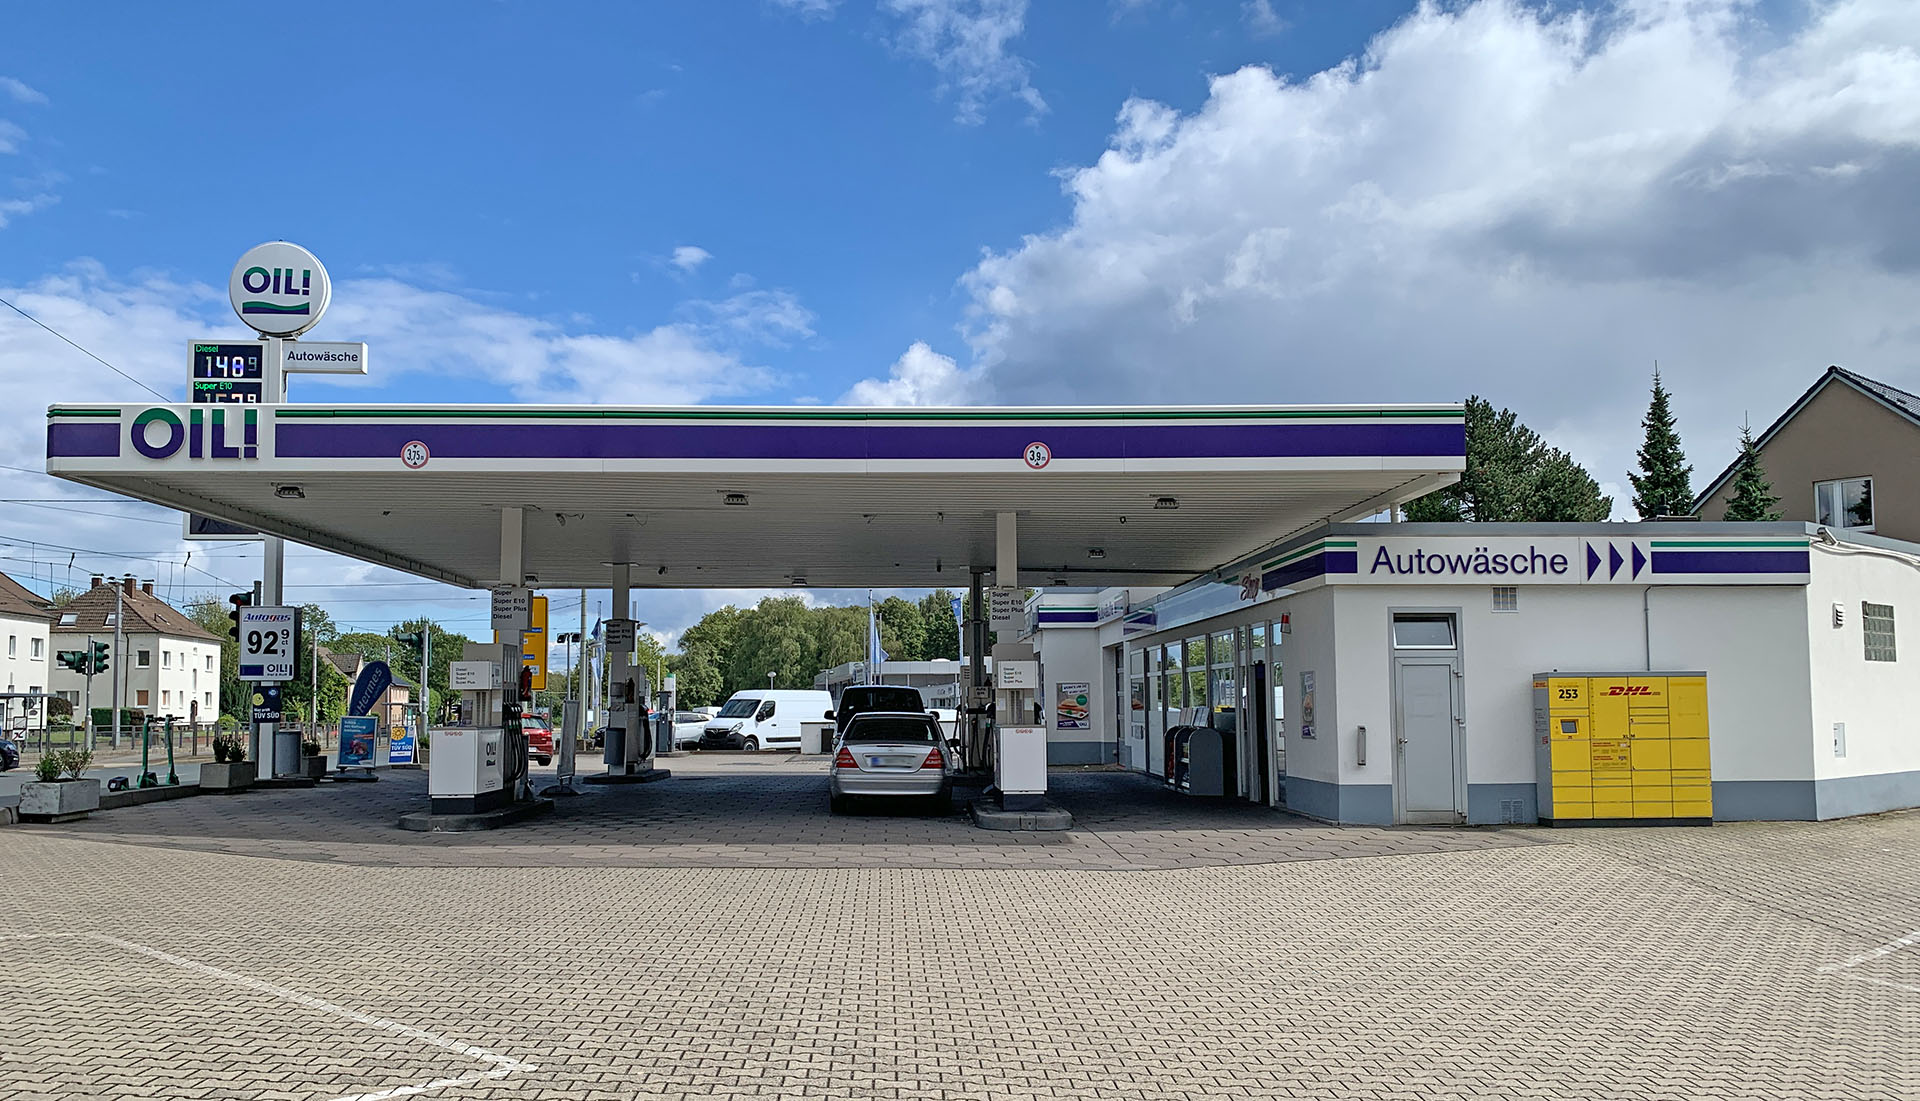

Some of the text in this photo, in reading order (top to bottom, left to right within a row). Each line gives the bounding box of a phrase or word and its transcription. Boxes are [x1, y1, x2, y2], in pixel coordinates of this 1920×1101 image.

[242, 266, 311, 296] OIL!
[195, 344, 219, 353] Diesel
[287, 350, 359, 362] Autowäsche
[194, 381, 233, 392] Super E10
[130, 407, 259, 460] OIL!
[1370, 545, 1569, 575] Autowäsche
[243, 613, 292, 623] Autogas
[266, 664, 288, 673] OIL!
[356, 667, 383, 714] Hermes
[1558, 689, 1579, 699] 253
[1608, 686, 1652, 696] DHL
